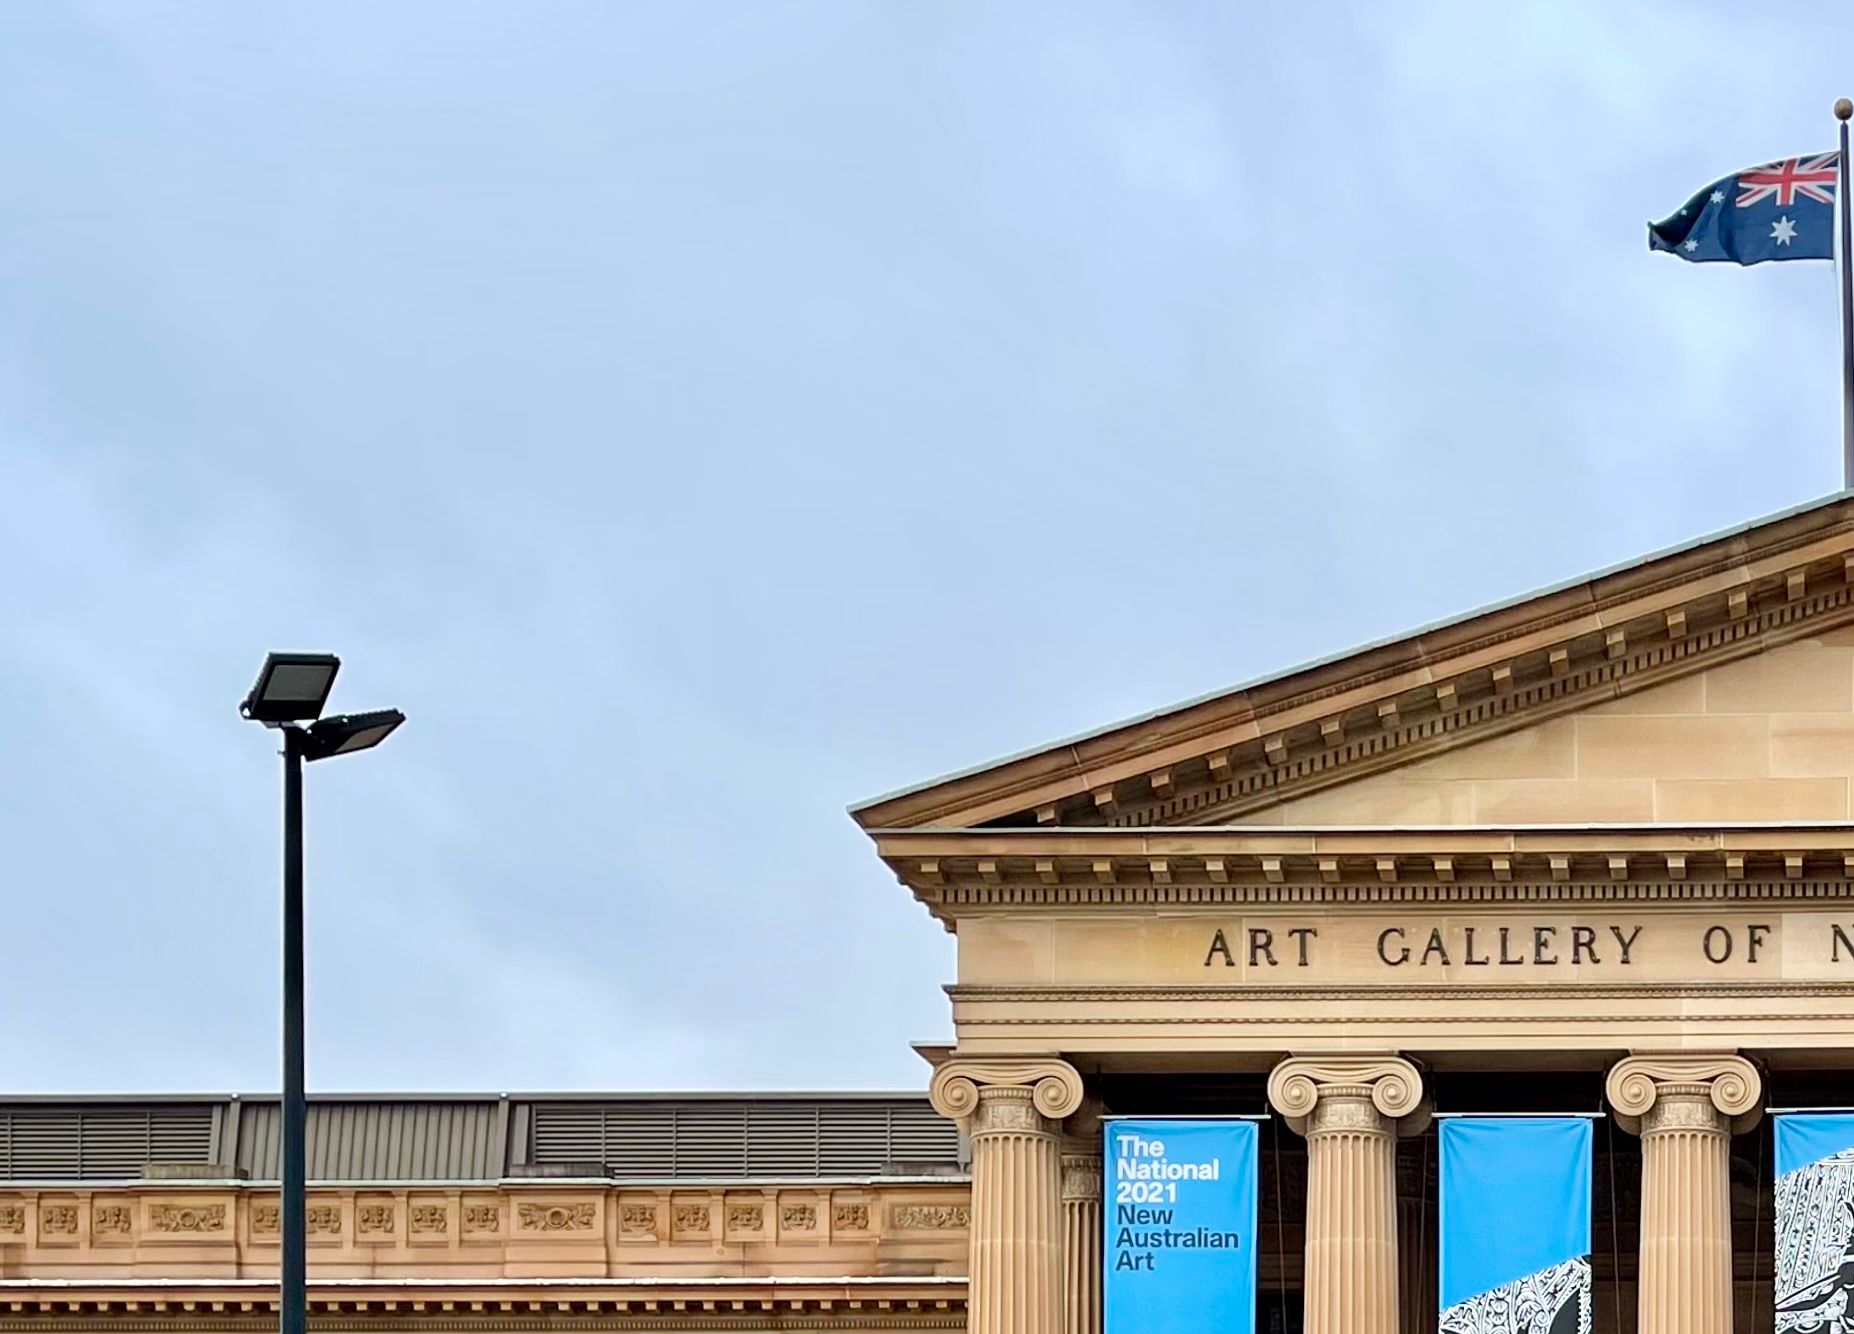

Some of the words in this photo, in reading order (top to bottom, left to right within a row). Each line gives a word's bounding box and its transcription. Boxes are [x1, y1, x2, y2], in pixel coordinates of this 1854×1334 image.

[1204, 928, 1318, 967] ART
[1377, 925, 1643, 967] GALLERY
[1703, 924, 1771, 964] OF
[1116, 1135, 1165, 1157] The
[1117, 1158, 1219, 1180] National
[1116, 1181, 1177, 1204] 2021
[1117, 1204, 1173, 1225] New
[1116, 1226, 1239, 1249] Australian
[1116, 1250, 1155, 1272] Art
